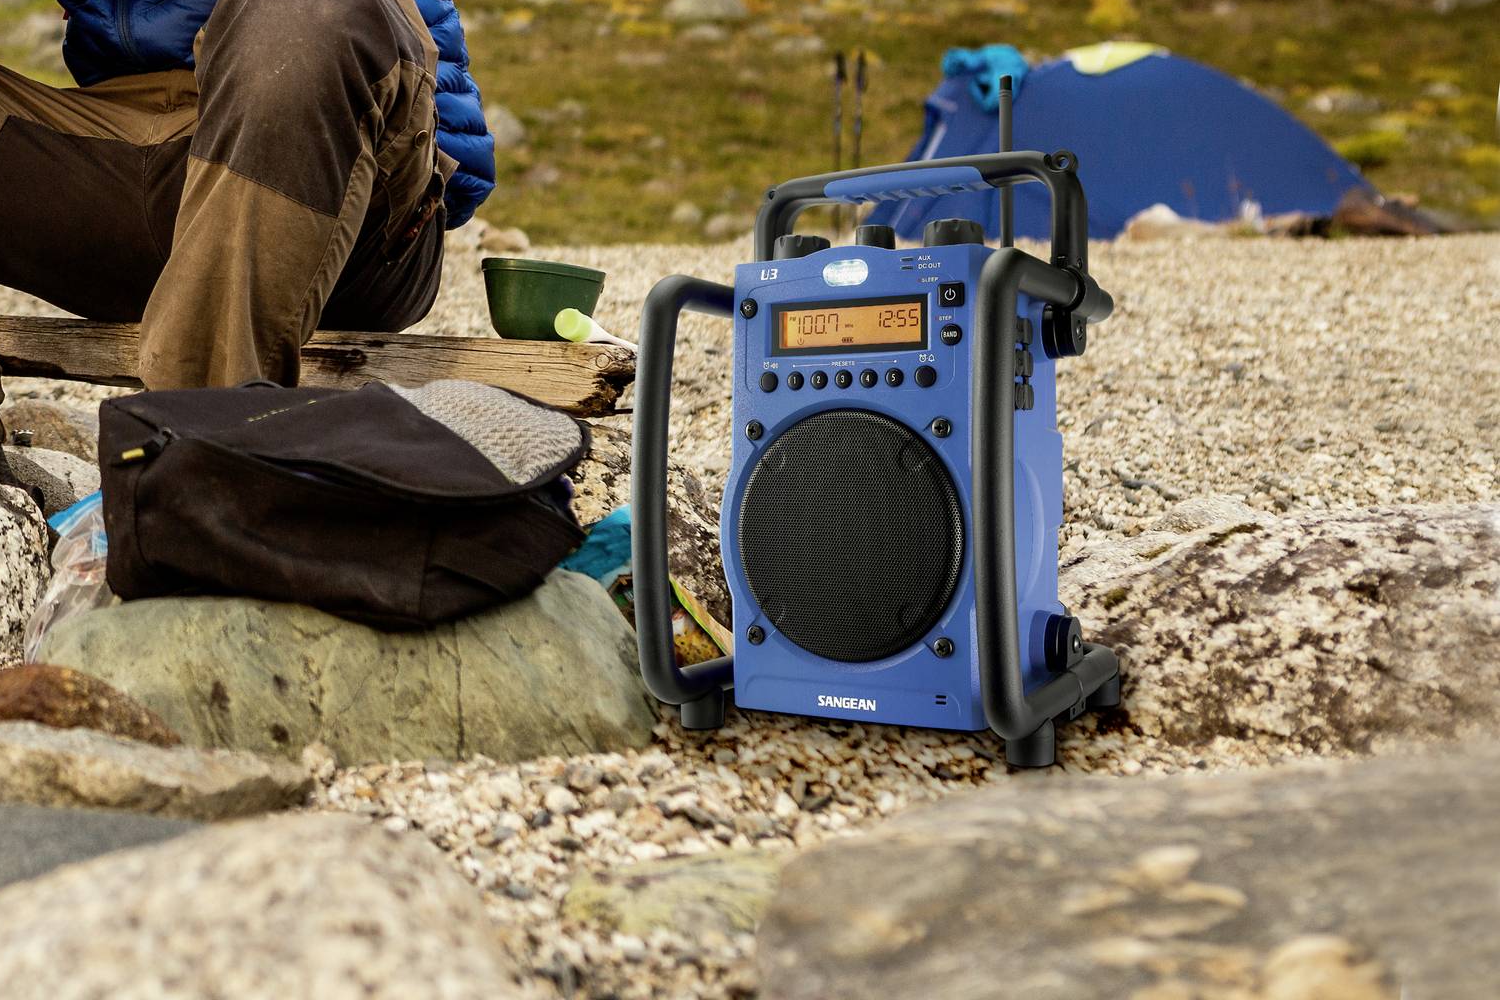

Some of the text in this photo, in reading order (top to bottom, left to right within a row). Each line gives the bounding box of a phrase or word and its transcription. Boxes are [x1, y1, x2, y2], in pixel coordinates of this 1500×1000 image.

[760, 268, 779, 281] U3
[798, 313, 839, 335] 100.7
[878, 308, 919, 328] 12:55
[830, 360, 856, 368] PRESETS
[817, 694, 877, 712] SANGEAN
